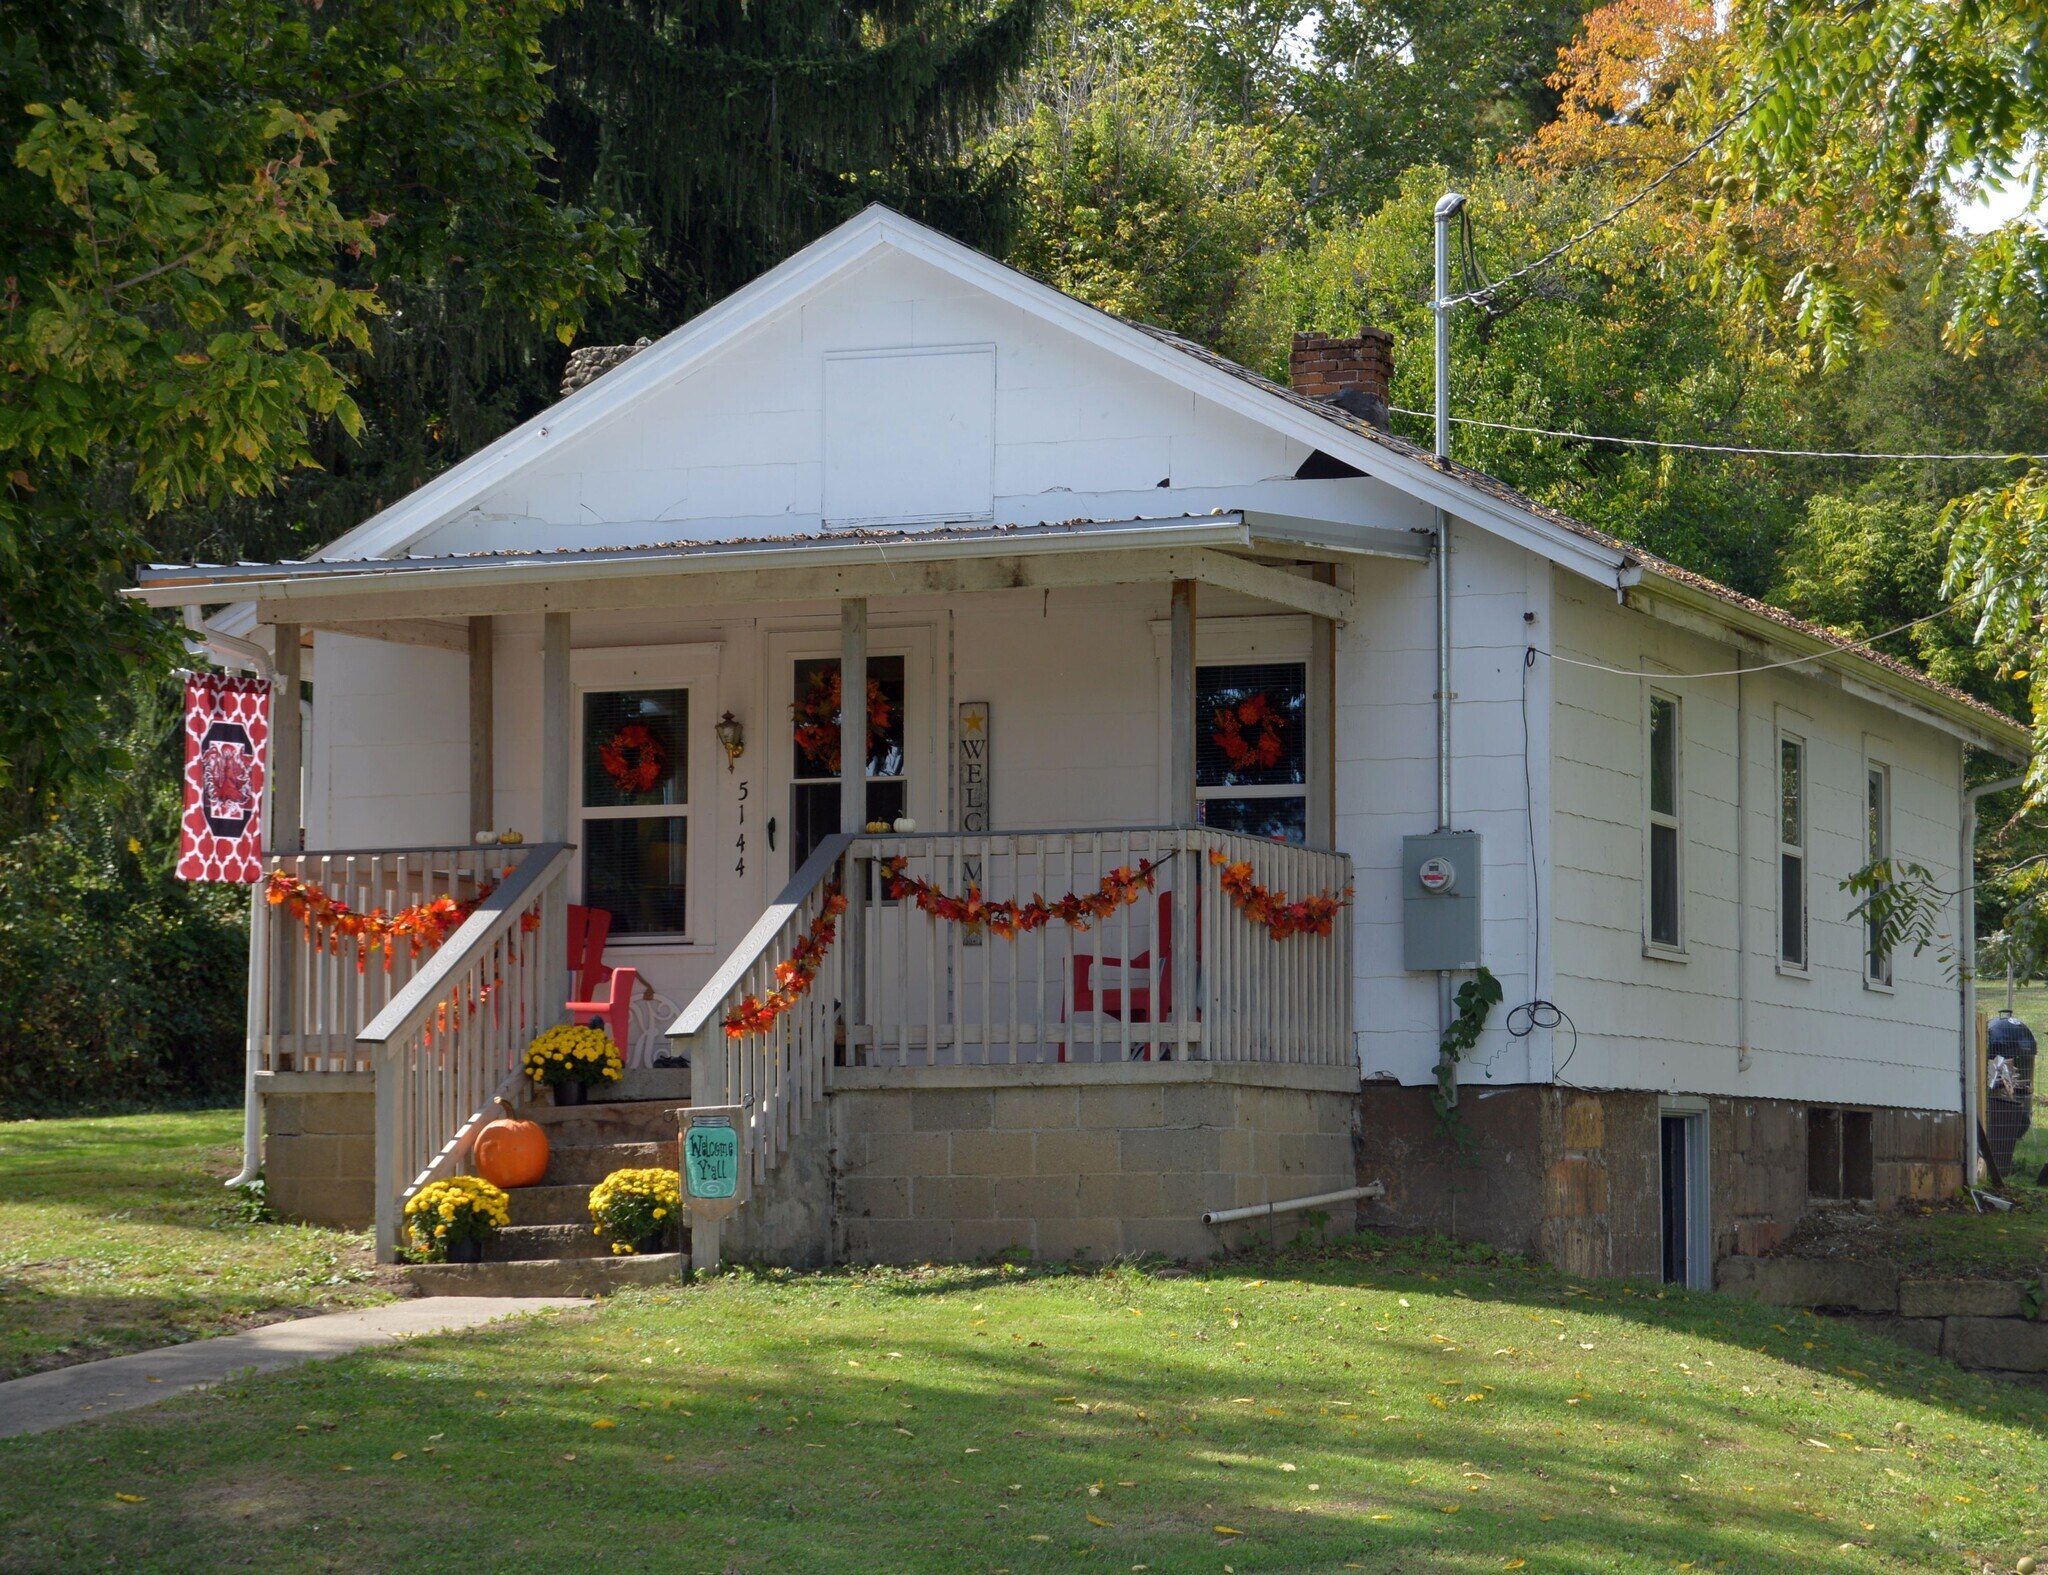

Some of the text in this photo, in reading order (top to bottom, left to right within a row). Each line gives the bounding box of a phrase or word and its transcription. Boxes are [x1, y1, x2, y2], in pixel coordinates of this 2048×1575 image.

[735, 780, 748, 878] 5144
[961, 739, 985, 900] WELCM
[689, 1134, 734, 1158] Welcome
[697, 1159, 727, 1180] Y'all
